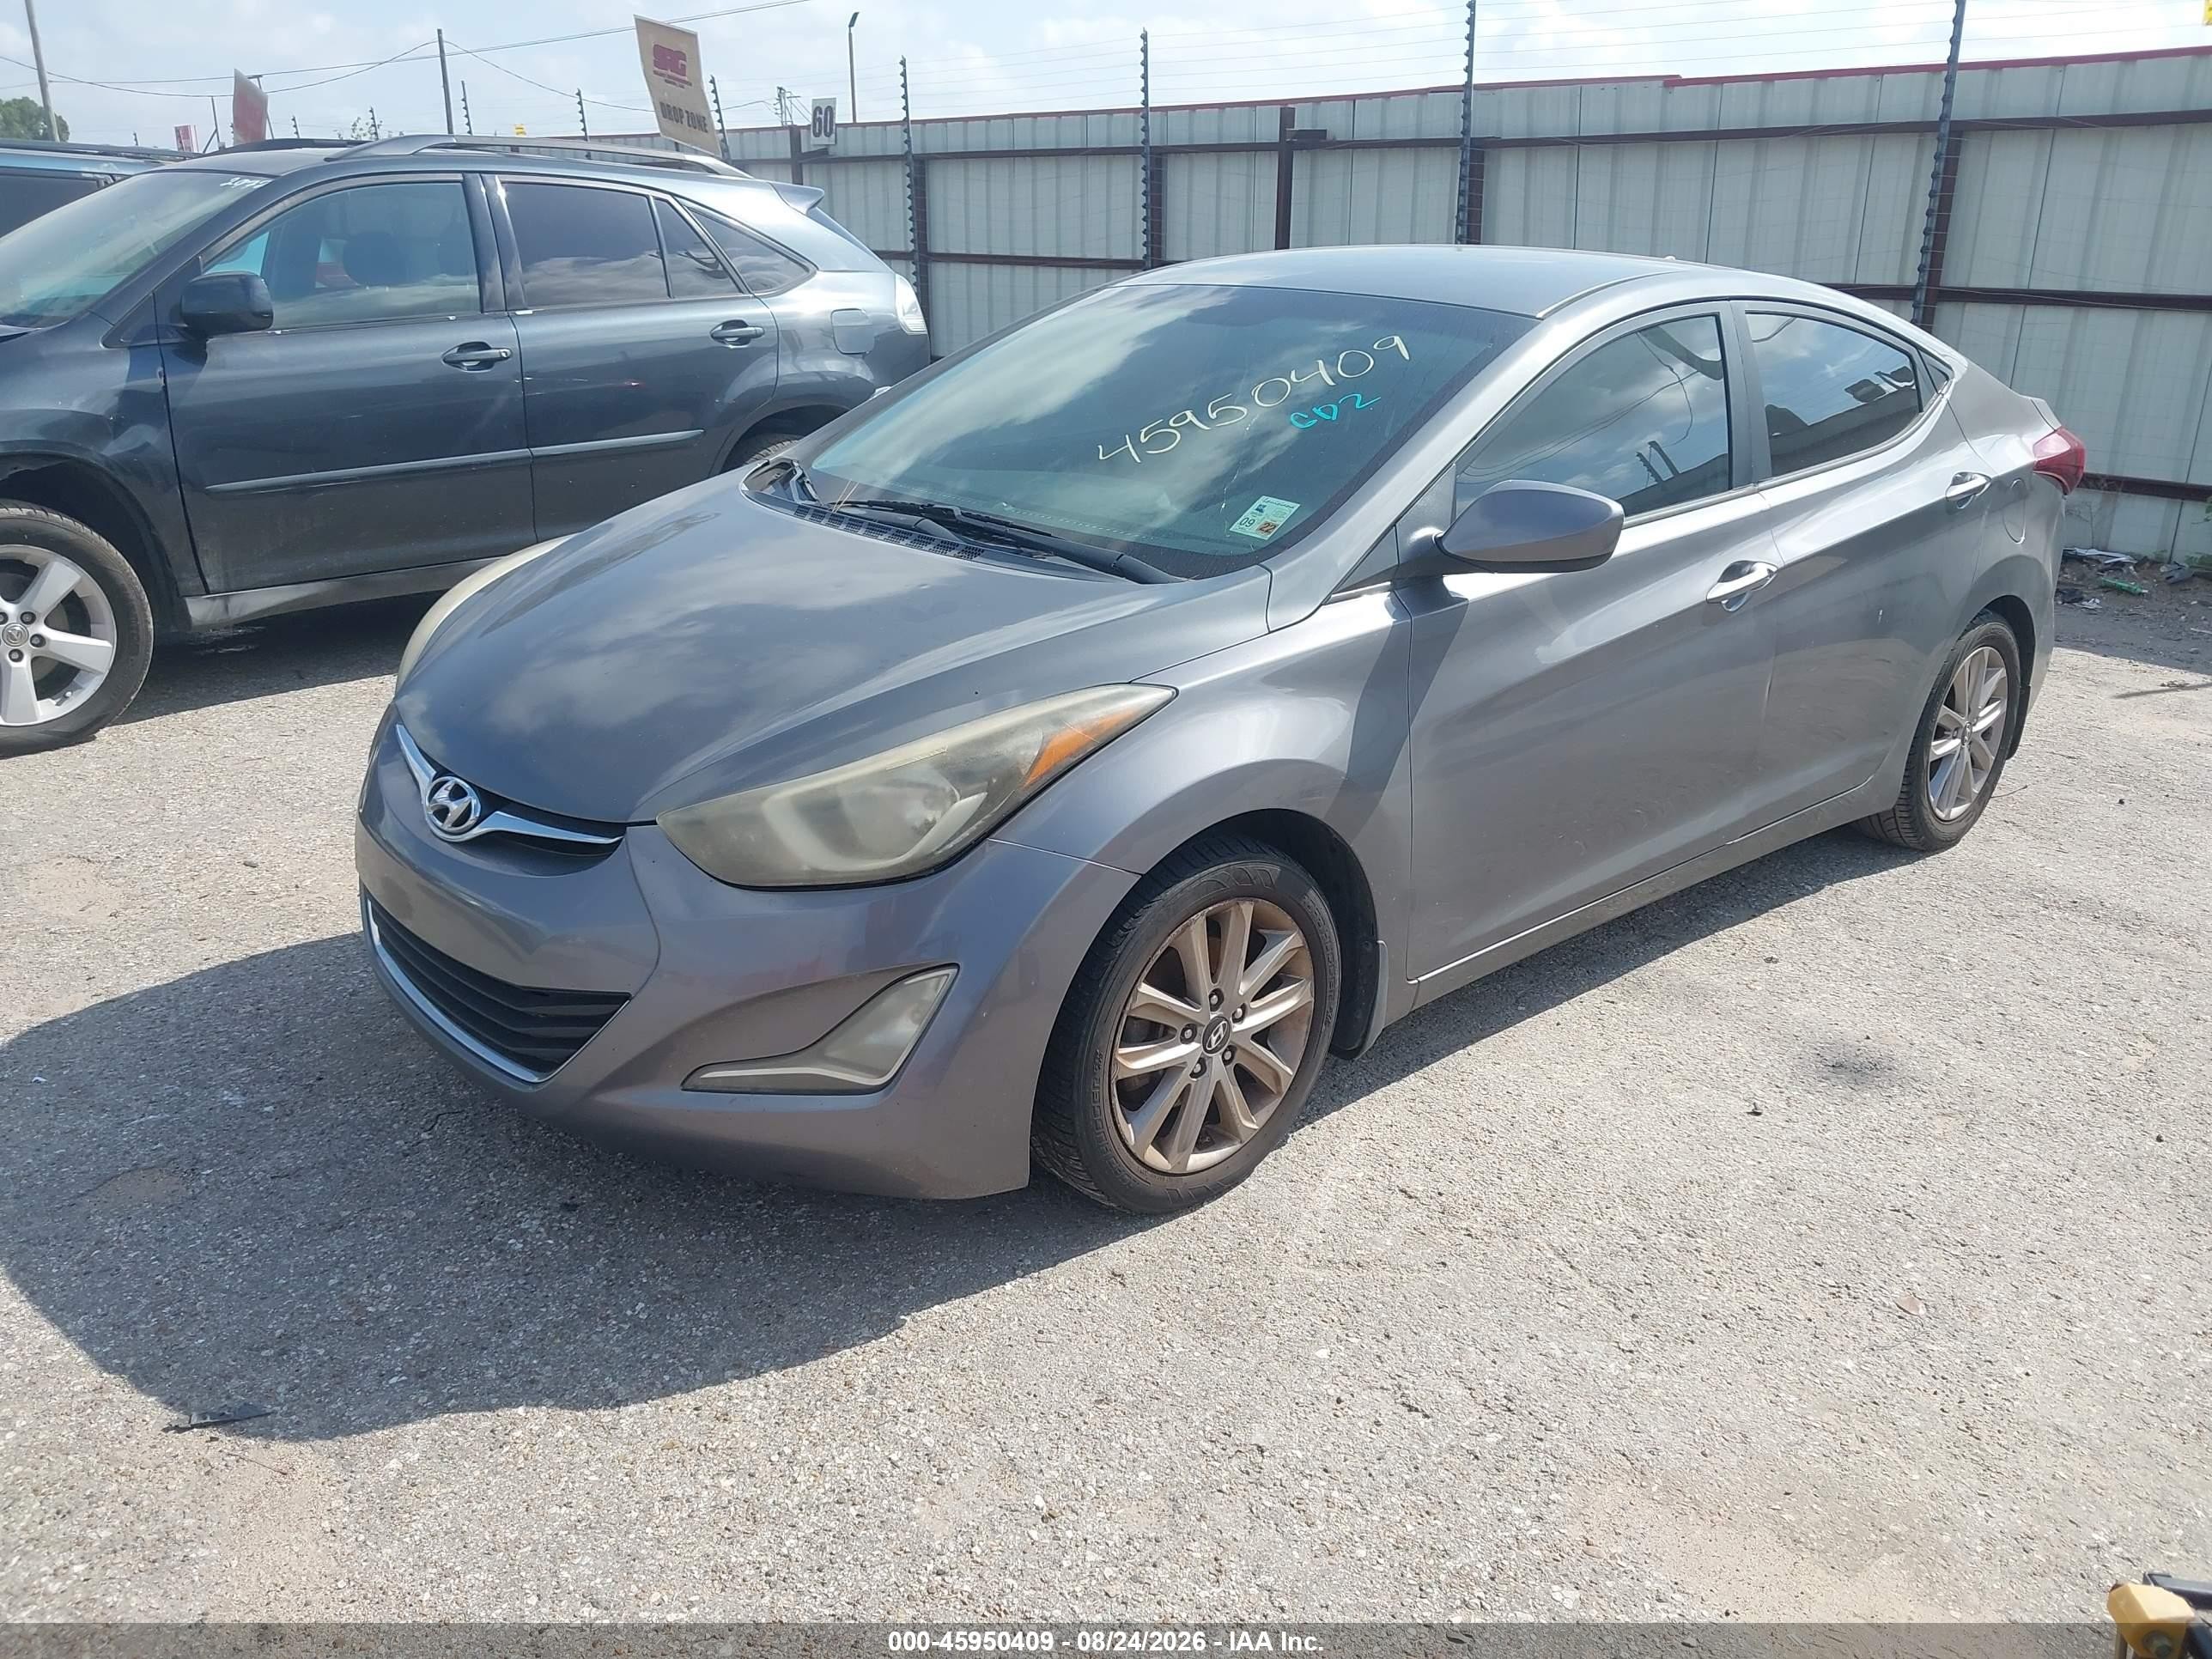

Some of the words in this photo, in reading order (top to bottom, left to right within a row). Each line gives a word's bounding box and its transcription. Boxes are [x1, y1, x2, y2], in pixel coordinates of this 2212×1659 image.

[659, 101, 684, 125] DROP
[685, 110, 708, 133] ZONE
[812, 105, 834, 138] 60
[1098, 335, 1410, 463] 45950409
[1239, 517, 1255, 527] 09
[1259, 522, 1277, 533] 22
